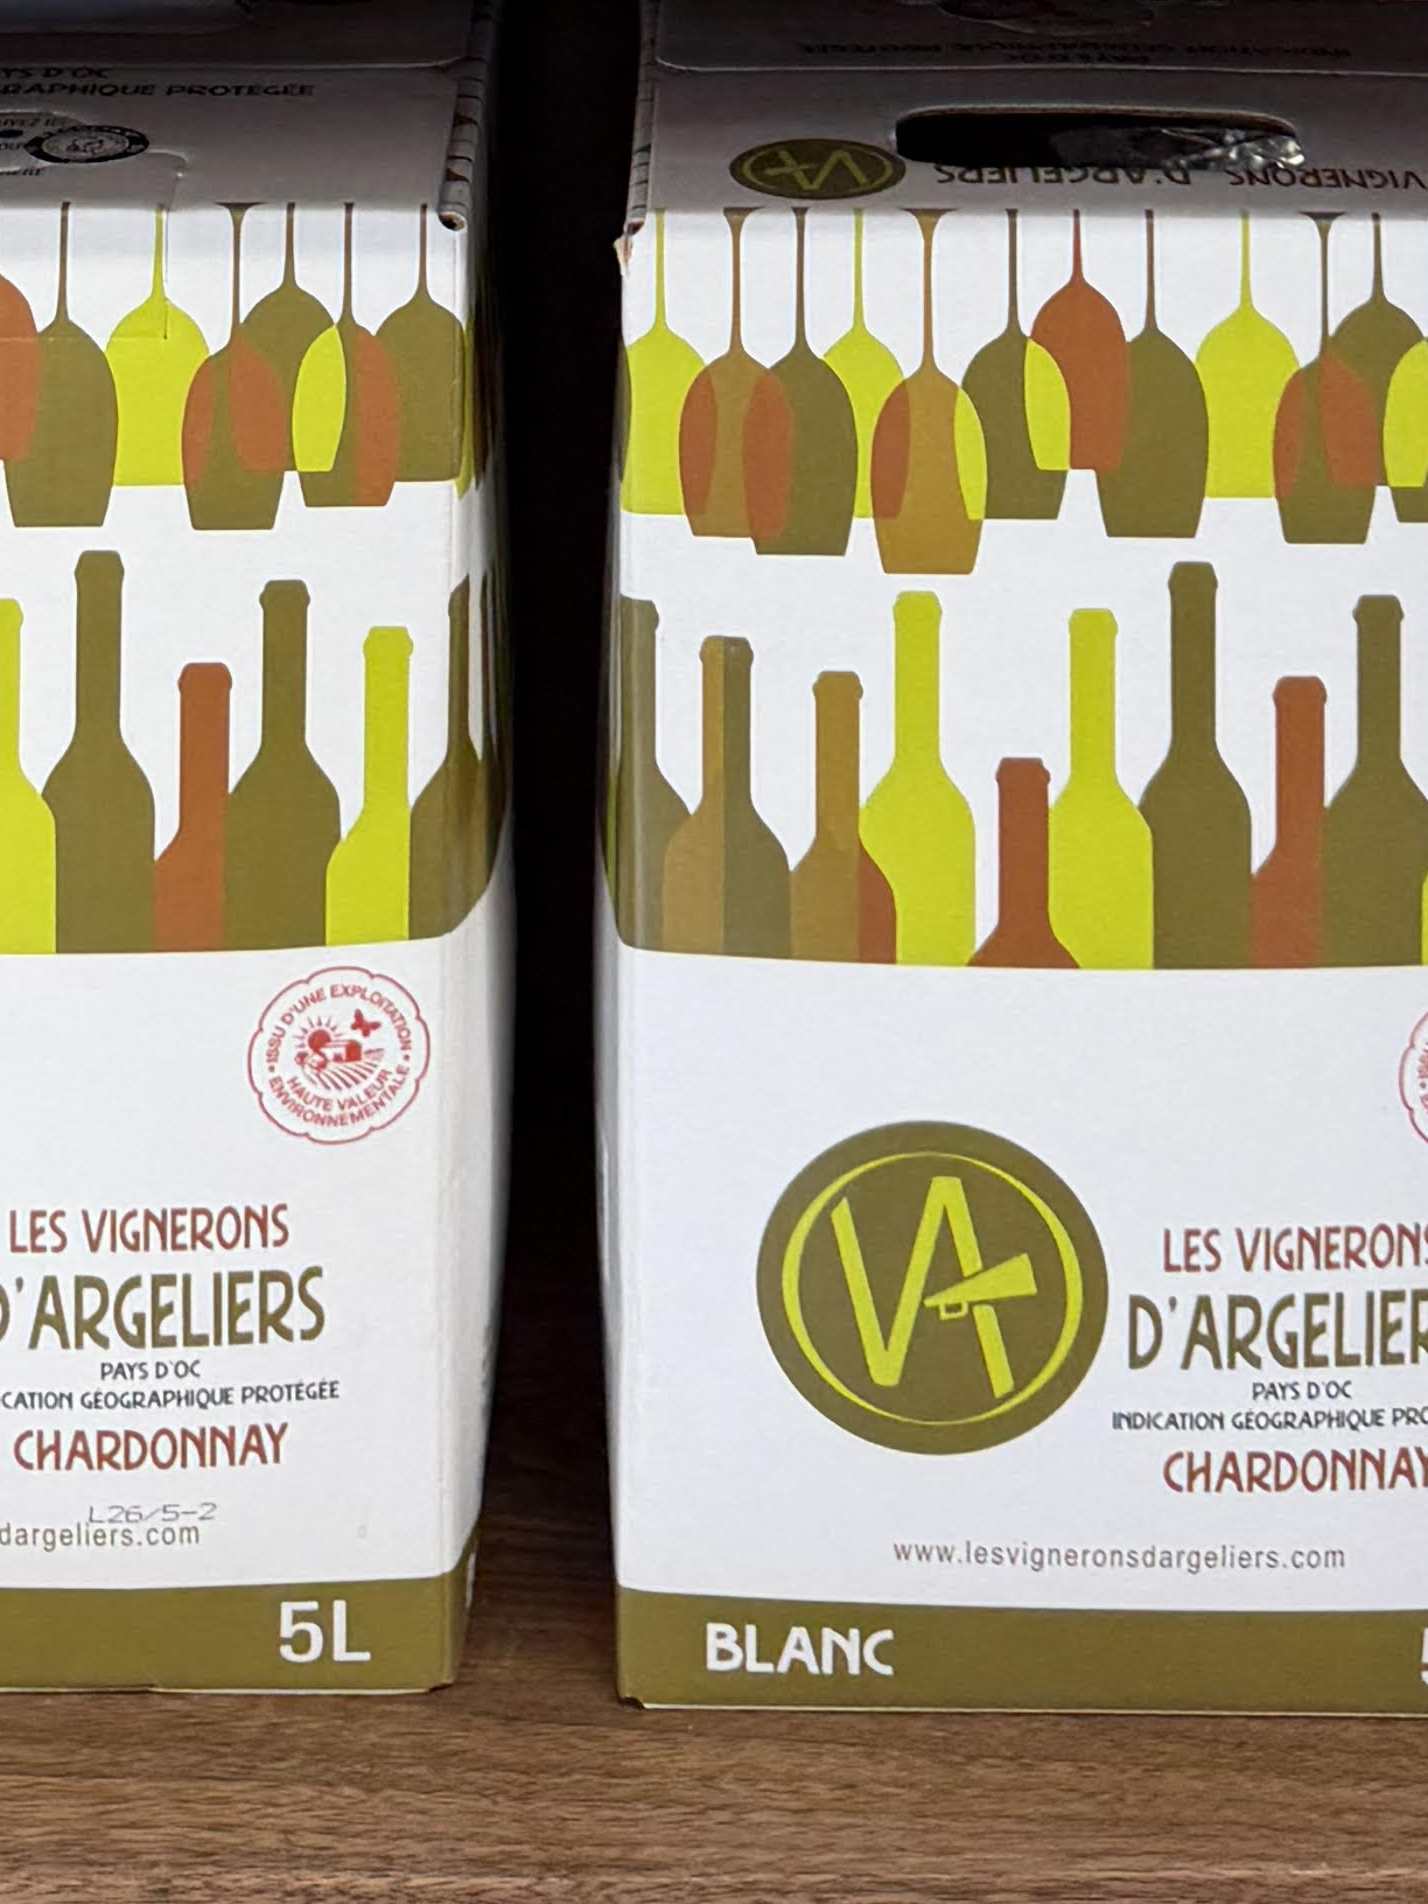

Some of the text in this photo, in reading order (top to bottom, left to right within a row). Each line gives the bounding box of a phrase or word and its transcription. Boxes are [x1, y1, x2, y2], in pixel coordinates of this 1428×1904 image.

[9, 1204, 289, 1255] LES VIGNERONS
[1163, 1228, 1221, 1273] LES
[100, 1360, 201, 1381] PAYS D'OC
[1253, 1380, 1352, 1401] PAYS D'OC
[81, 1385, 234, 1414] GÉOGRAPHIQUE
[242, 1380, 340, 1406] PROTÉGÉE
[1113, 1410, 1223, 1430] INDICATION
[1231, 1405, 1385, 1432] GÉOGRAPHIQUE
[14, 1423, 287, 1472] CHARDONNAY
[893, 1539, 1346, 1574] www.lesvigneronsdargeliers.com
[278, 1601, 370, 1663] 5L
[706, 1624, 893, 1677] BLANC
